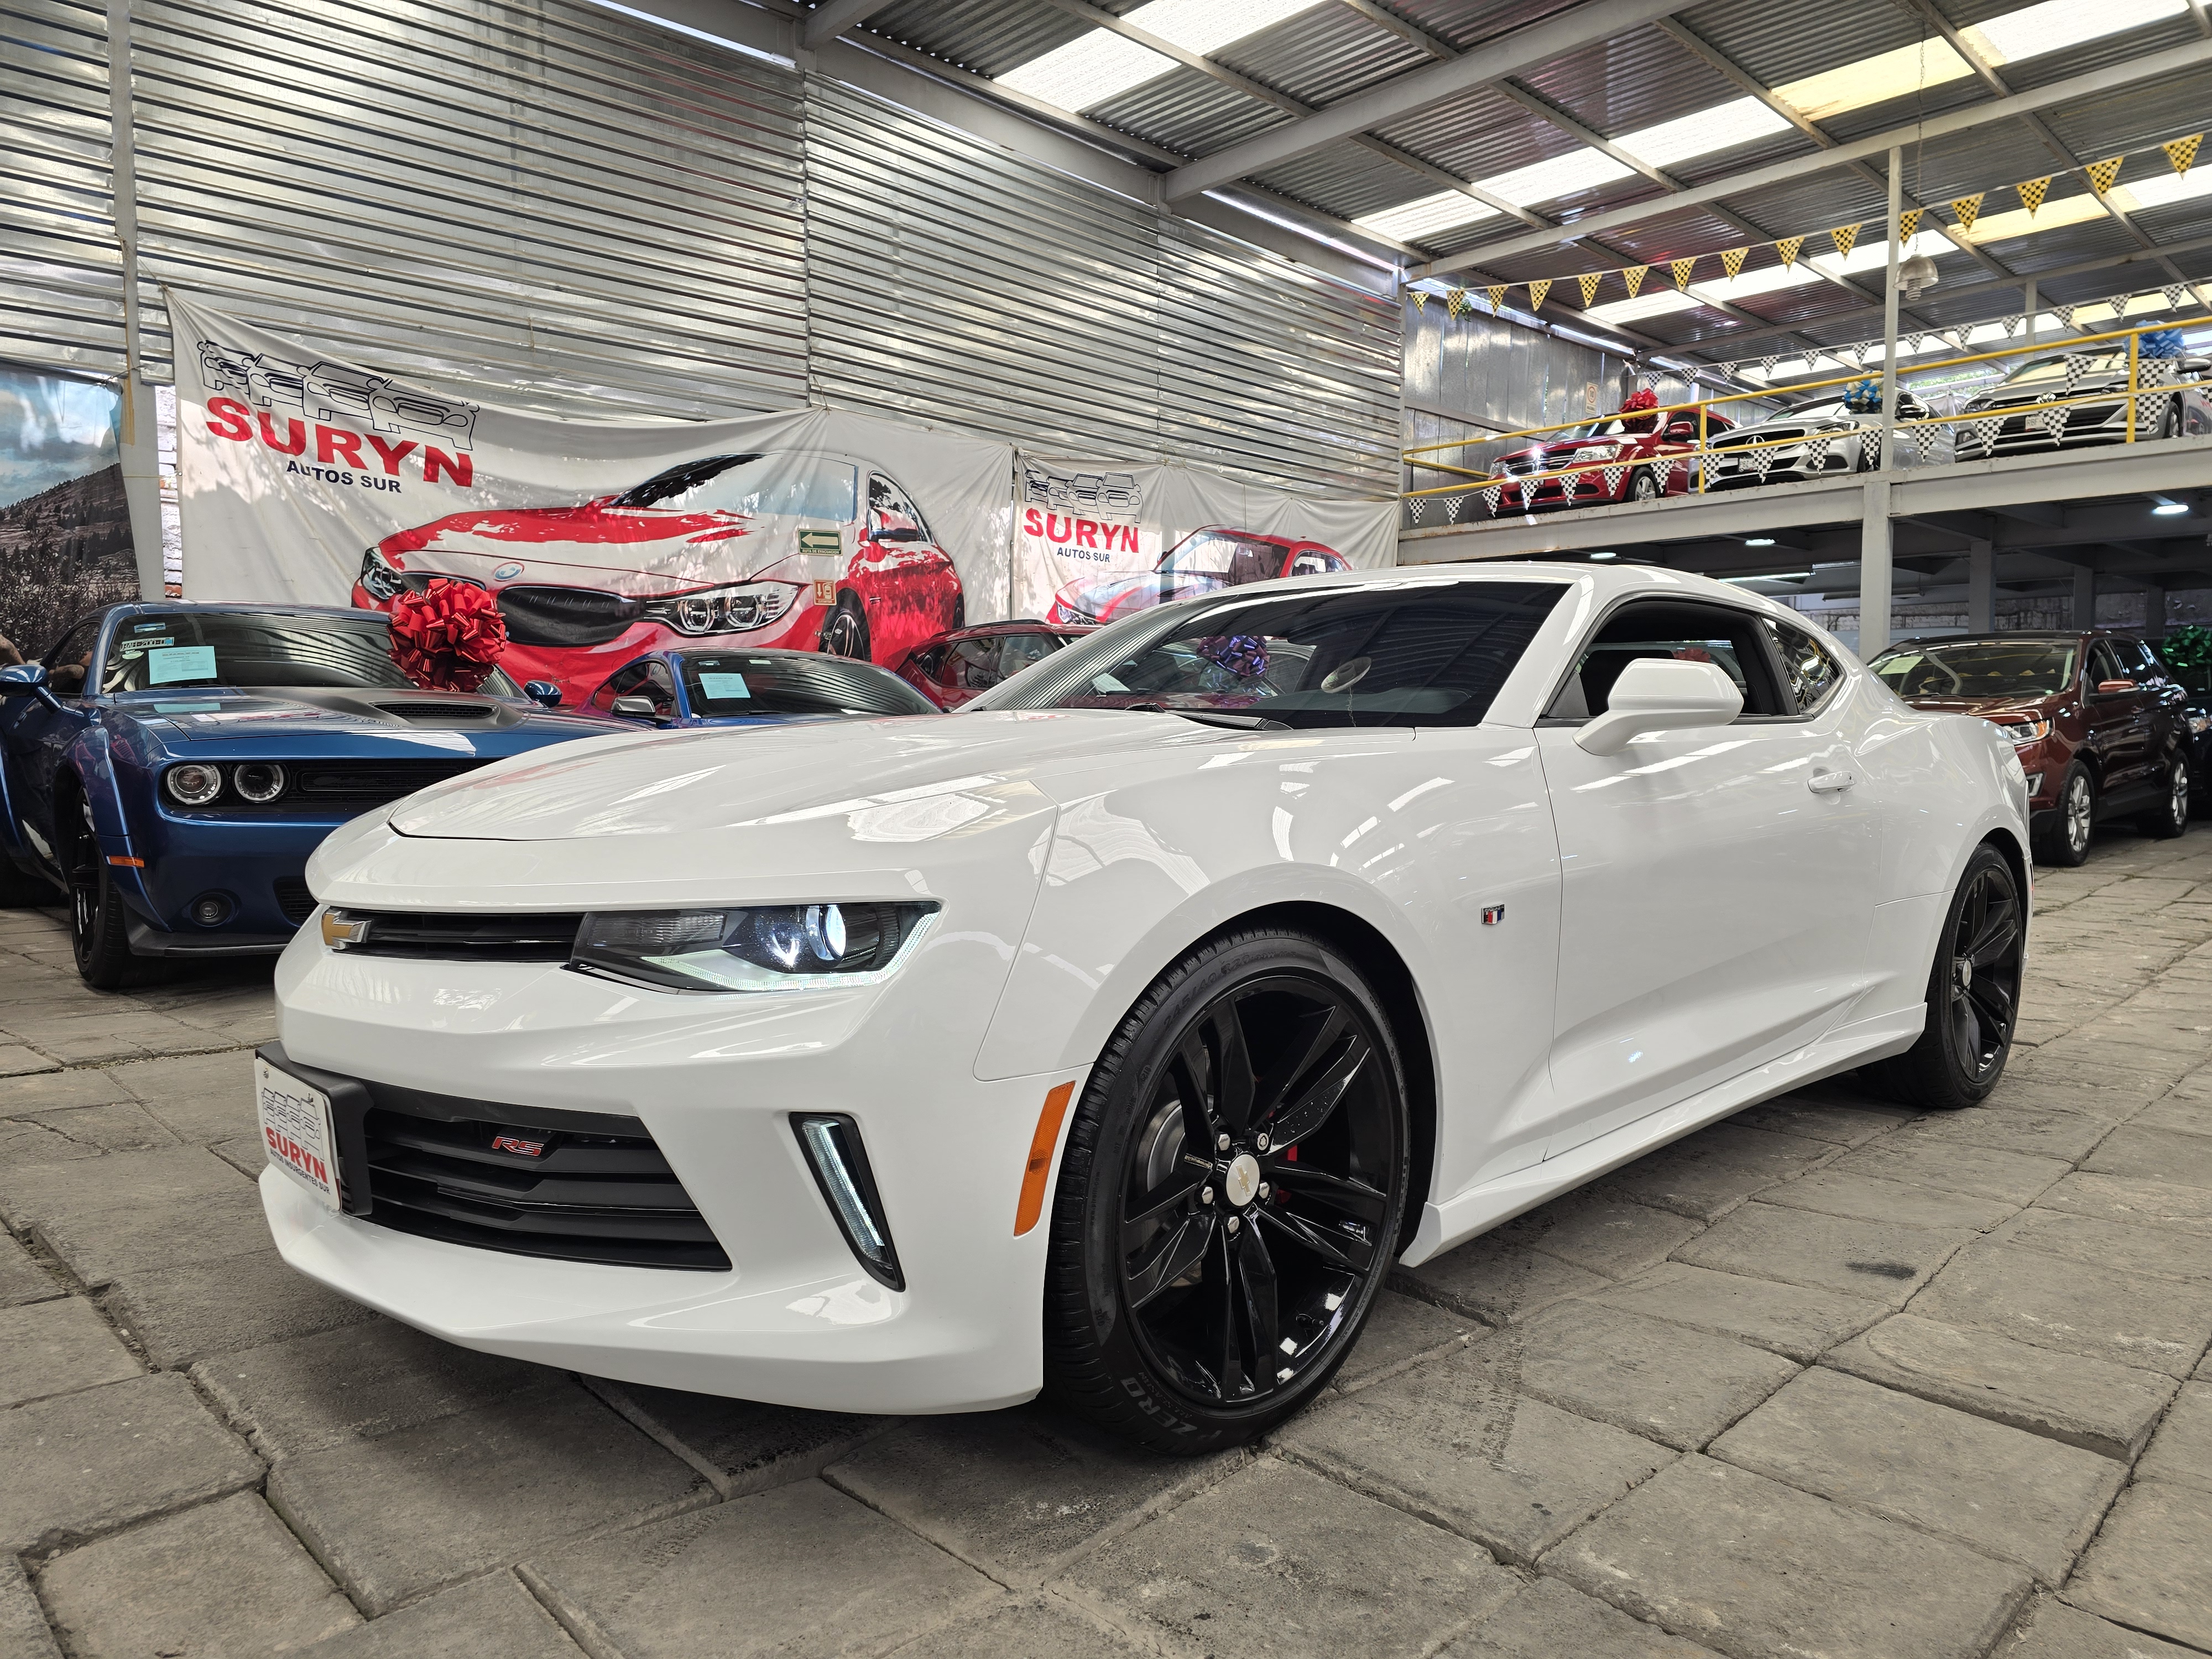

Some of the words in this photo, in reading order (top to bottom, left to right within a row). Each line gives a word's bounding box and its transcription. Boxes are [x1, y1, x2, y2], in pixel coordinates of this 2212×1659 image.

[206, 397, 474, 488] SURYN
[286, 460, 354, 486] AUTOS
[360, 475, 402, 493] SUR
[1024, 508, 1139, 553] SURYN
[1057, 547, 1091, 560] AUTOS
[1093, 552, 1110, 563] SUR
[266, 1126, 328, 1185] SURYN
[492, 1136, 544, 1156] RS
[1120, 1377, 1198, 1437] ZERO
